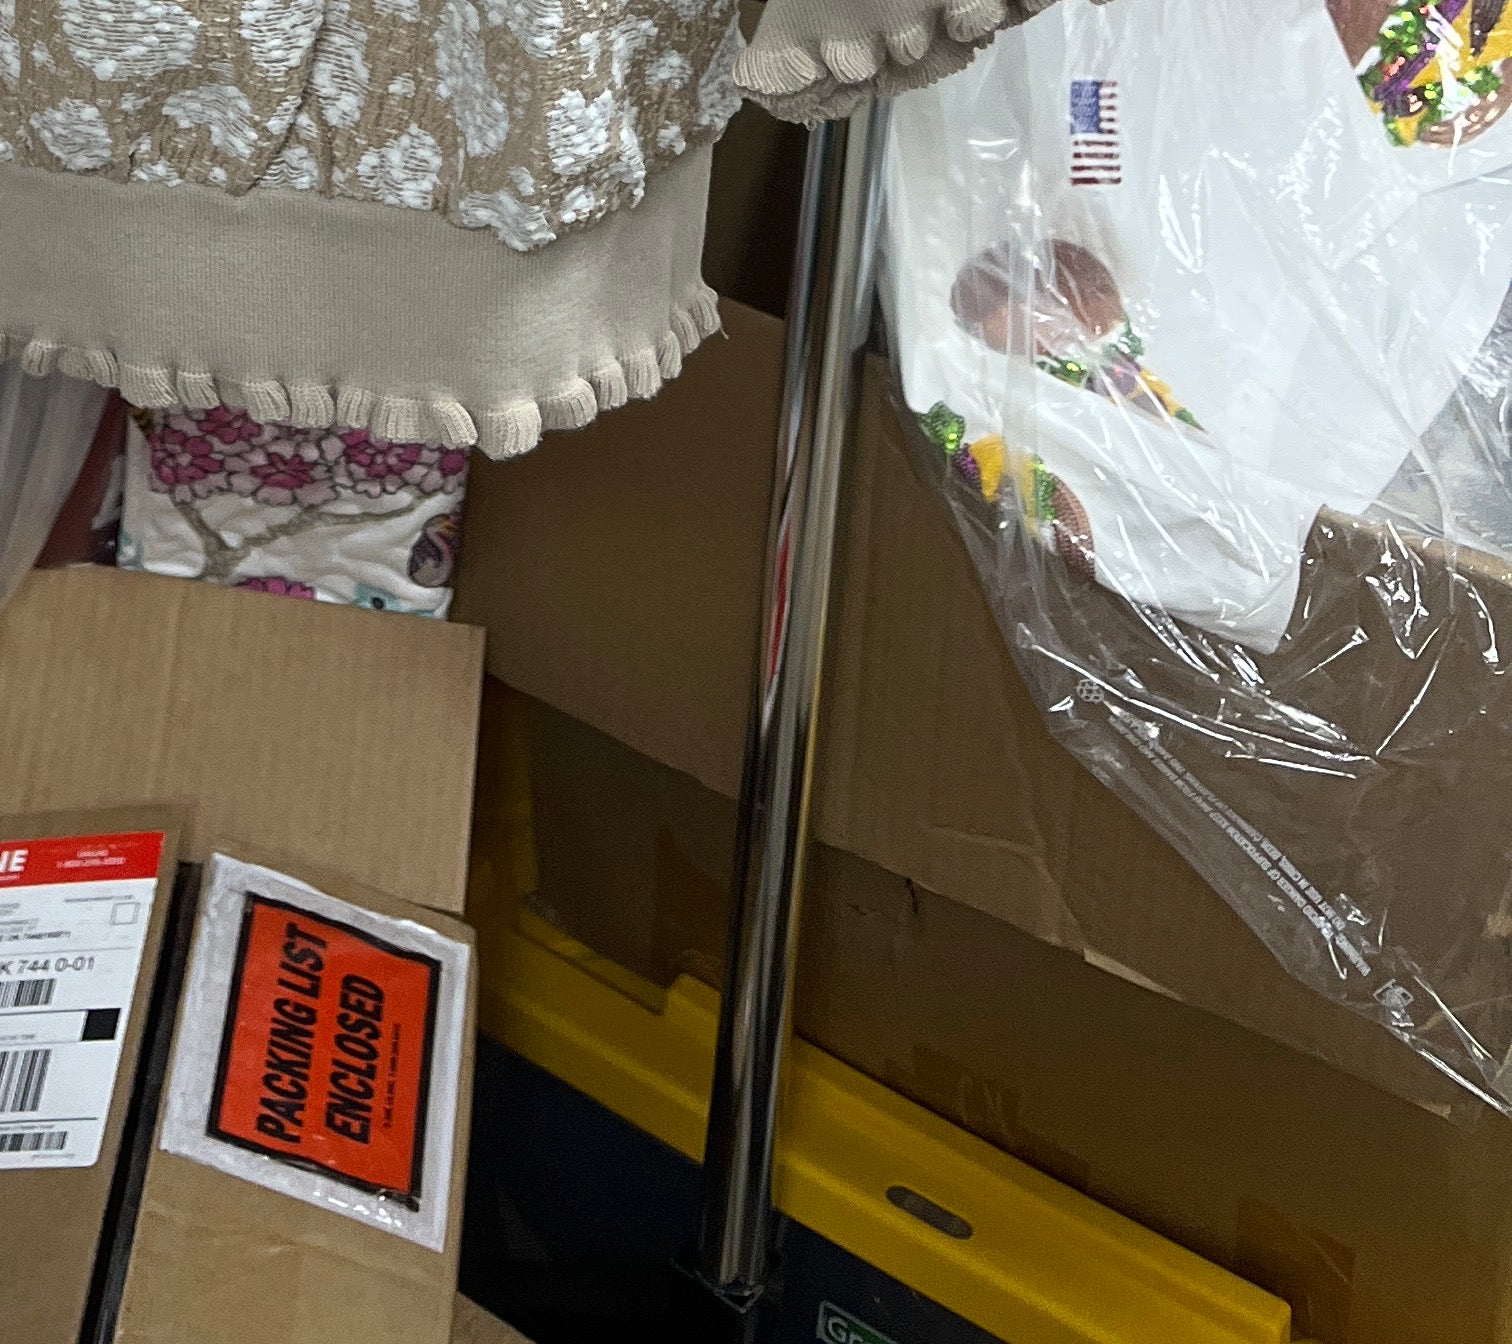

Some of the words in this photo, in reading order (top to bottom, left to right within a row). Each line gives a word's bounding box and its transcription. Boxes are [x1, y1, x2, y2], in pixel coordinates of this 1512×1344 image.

[279, 923, 328, 999] LIST
[256, 999, 317, 1144] PACKING
[325, 974, 385, 1146] ENCLOSED
